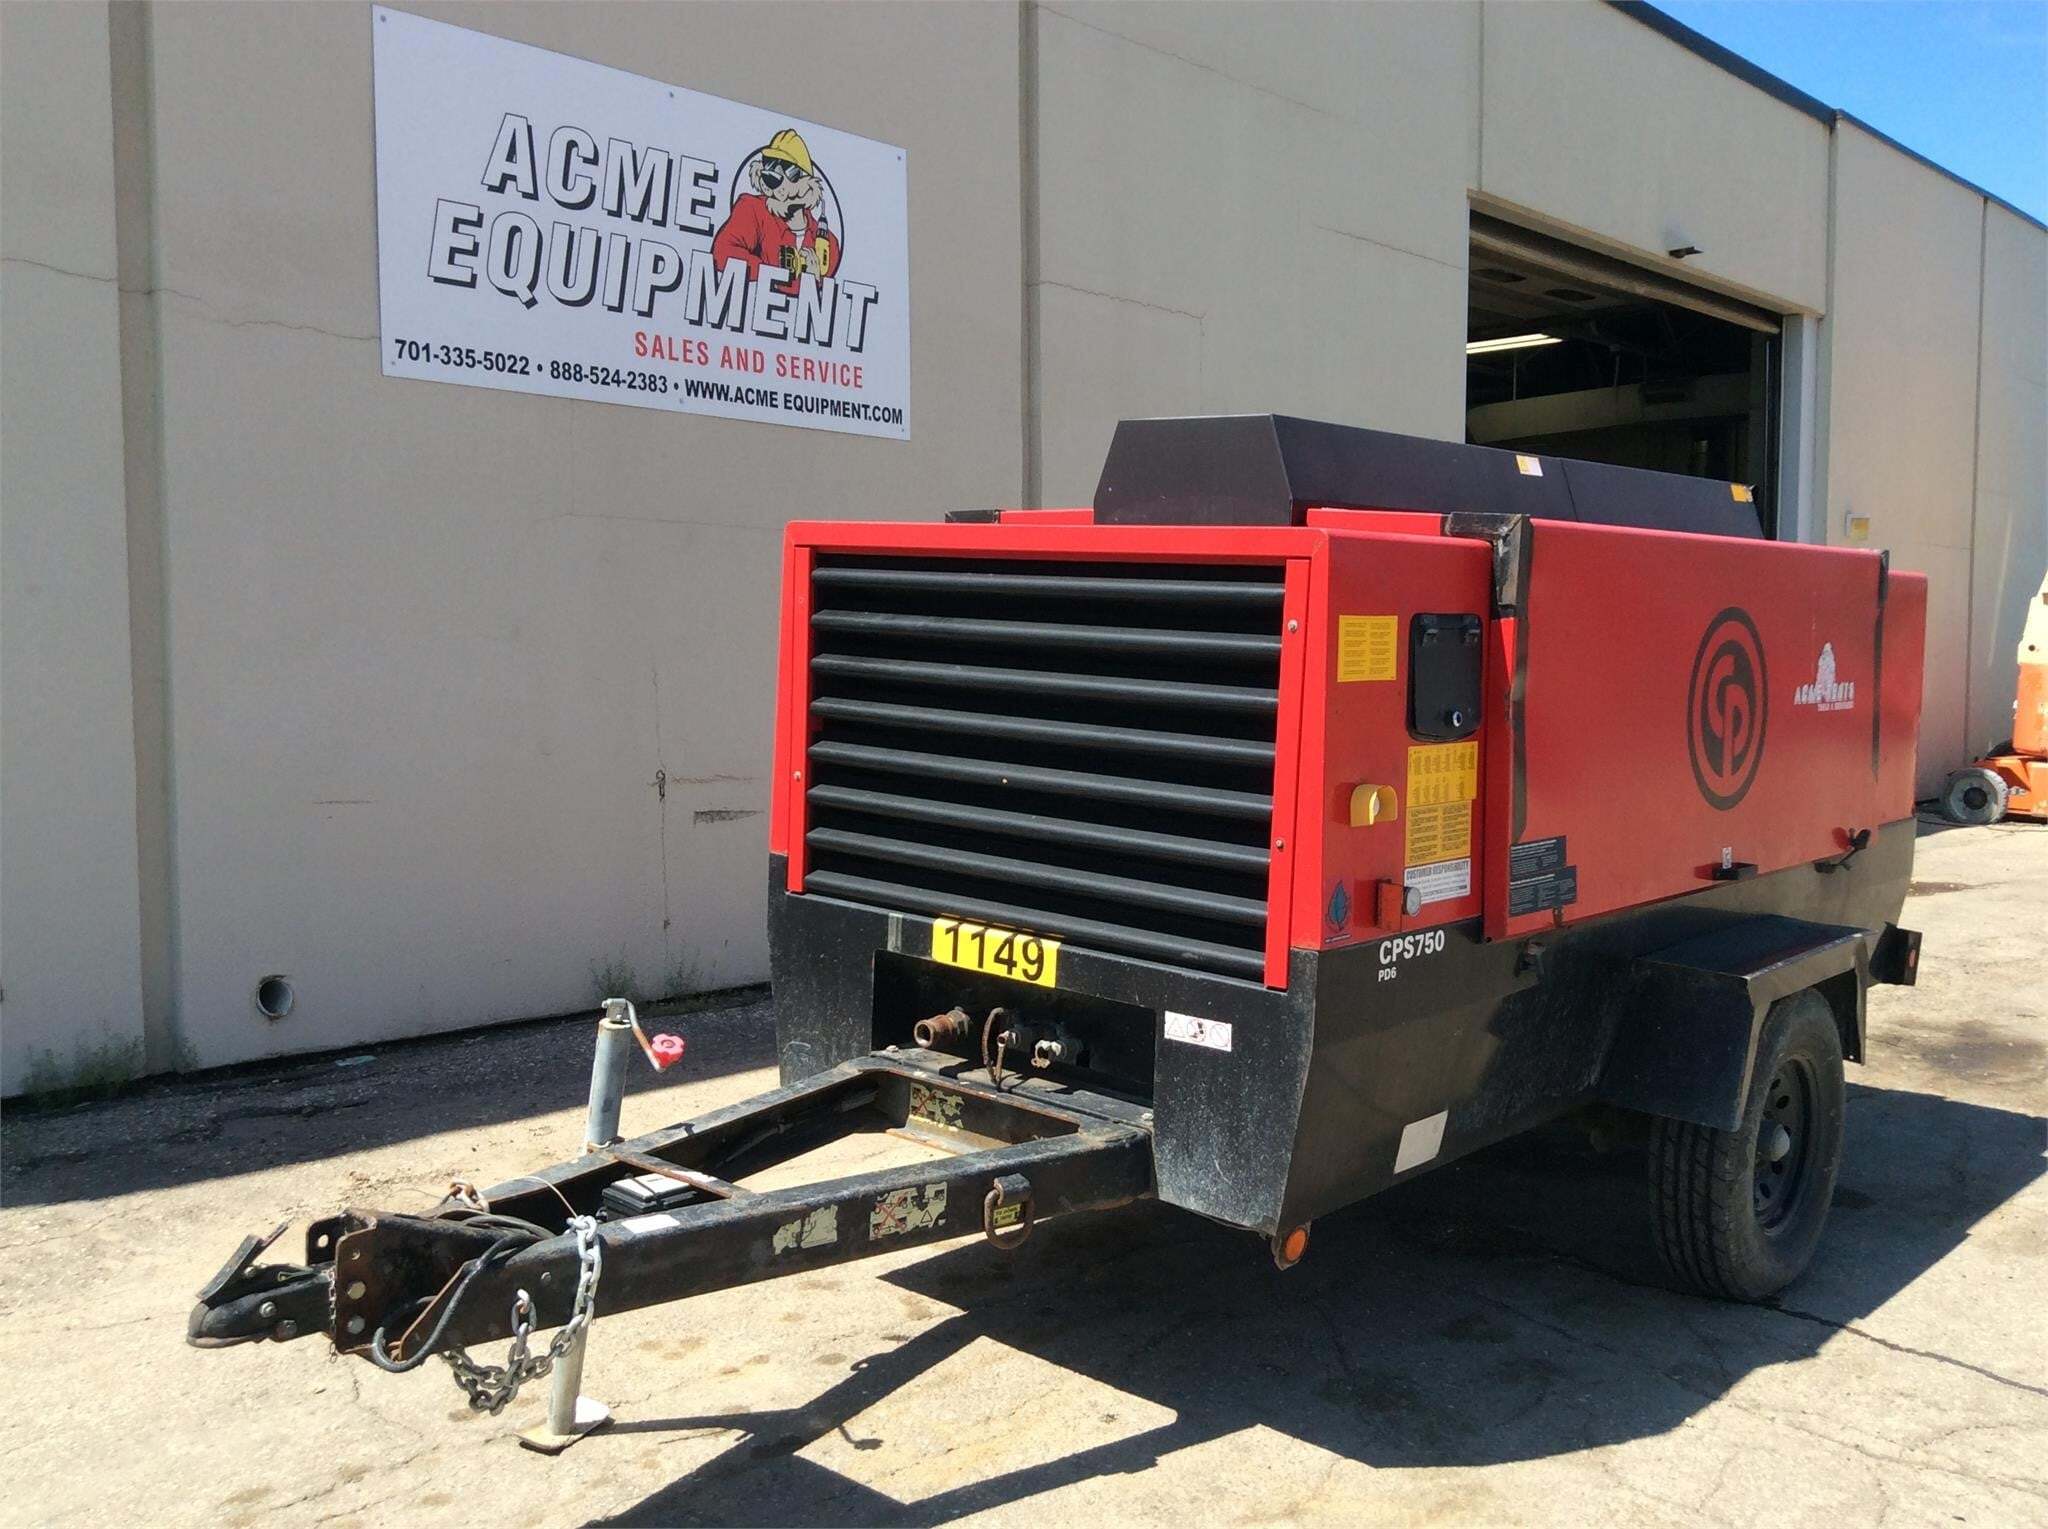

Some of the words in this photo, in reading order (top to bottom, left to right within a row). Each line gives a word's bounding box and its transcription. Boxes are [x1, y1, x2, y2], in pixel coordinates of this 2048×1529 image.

[481, 113, 719, 237] ACME
[427, 198, 878, 352] EQUIPMENT
[394, 339, 530, 376] 701-335-5022
[550, 360, 668, 394] 888-524-2383
[634, 331, 710, 366] SALES
[720, 345, 765, 374] AND
[776, 353, 863, 388] SERVICE
[944, 921, 1045, 981] 1149
[1378, 966, 1397, 982] PD6
[1379, 929, 1445, 965] CPS750
